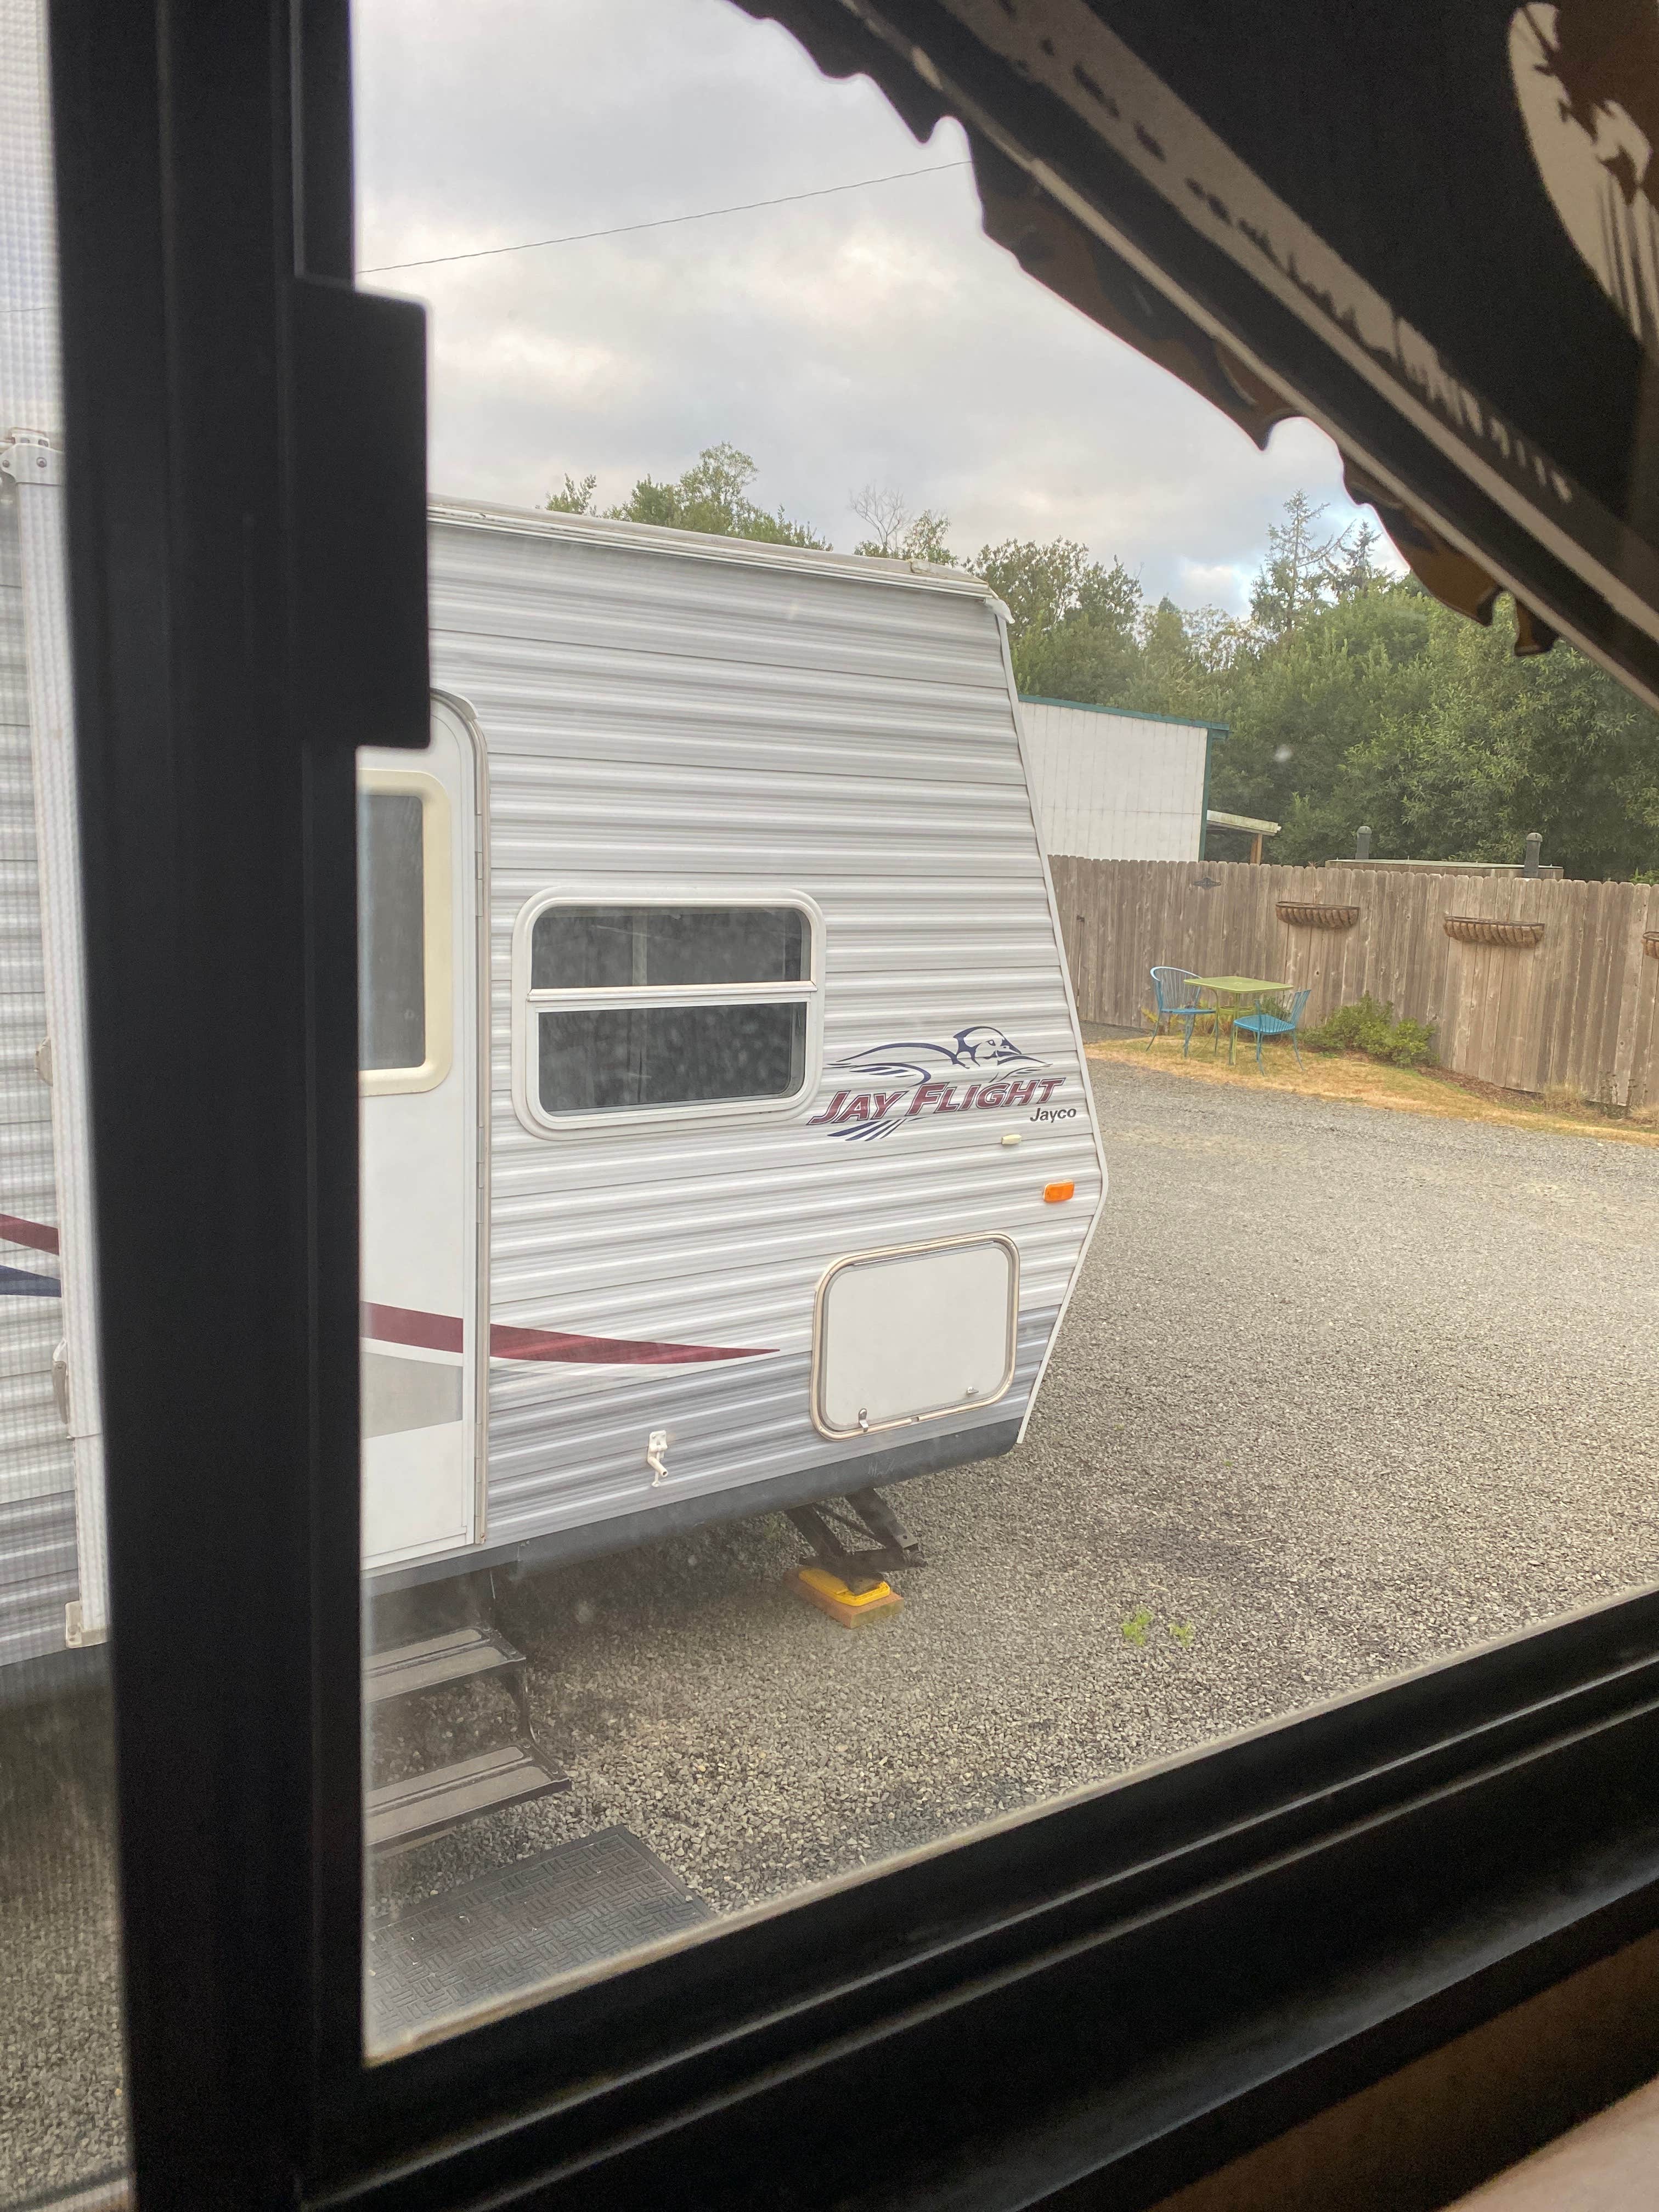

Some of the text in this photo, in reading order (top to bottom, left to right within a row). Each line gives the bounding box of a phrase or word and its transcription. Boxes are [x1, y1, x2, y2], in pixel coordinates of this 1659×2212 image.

[805, 1077, 1066, 1125] JAY FLIGHT
[1030, 1107, 1076, 1123] Jayco
